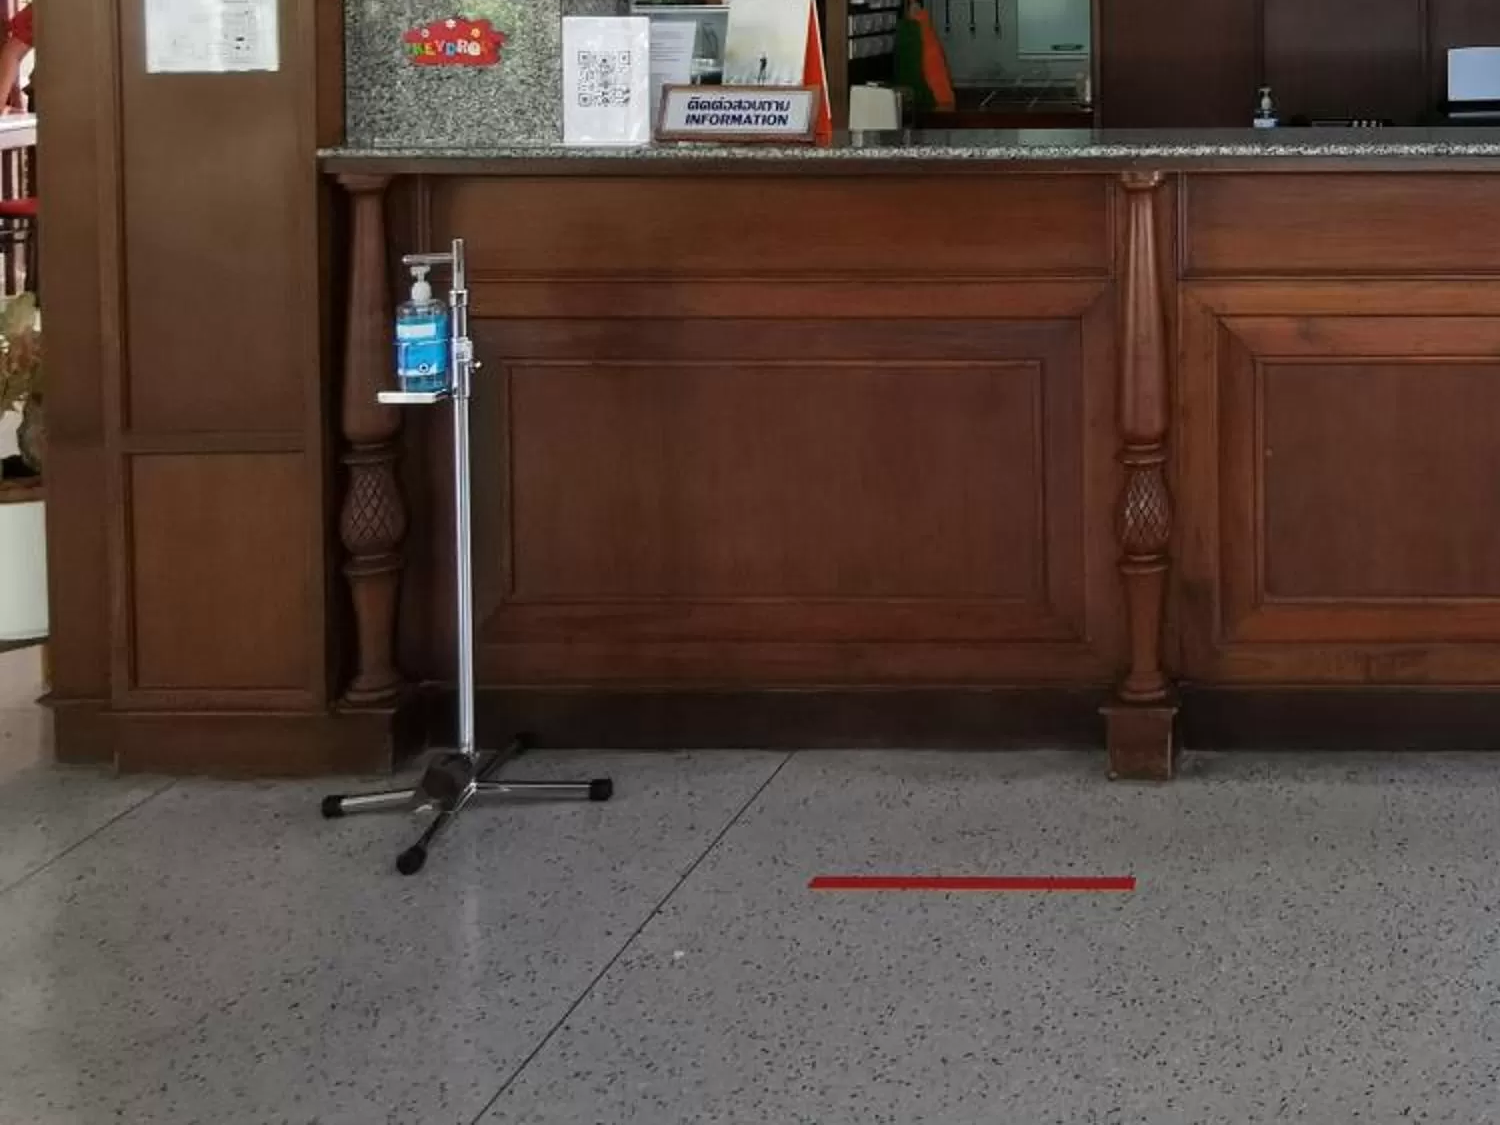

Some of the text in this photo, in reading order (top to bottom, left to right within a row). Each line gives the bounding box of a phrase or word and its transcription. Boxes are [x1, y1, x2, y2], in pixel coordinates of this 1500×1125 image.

[687, 96, 791, 112] ติดต่อสอบถาม
[684, 114, 789, 126] INFORMATION
